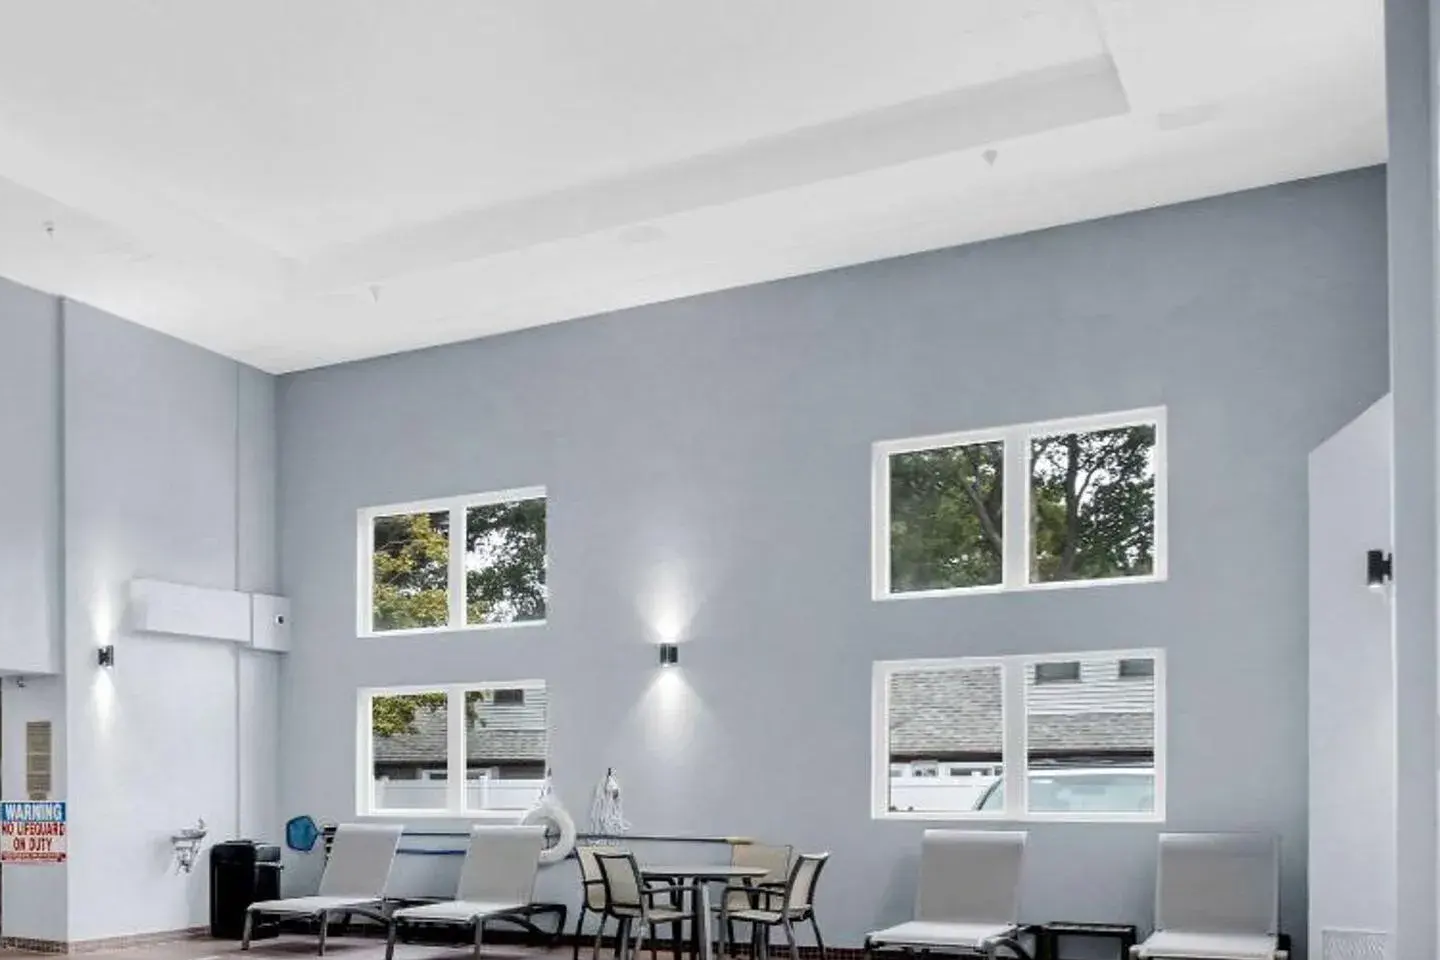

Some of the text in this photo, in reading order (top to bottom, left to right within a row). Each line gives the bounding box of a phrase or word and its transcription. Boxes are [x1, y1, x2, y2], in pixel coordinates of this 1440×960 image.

[5, 803, 63, 821] WARNING
[2, 822, 65, 836] NO LIFEGUARD
[13, 837, 52, 851] ON DUTY
